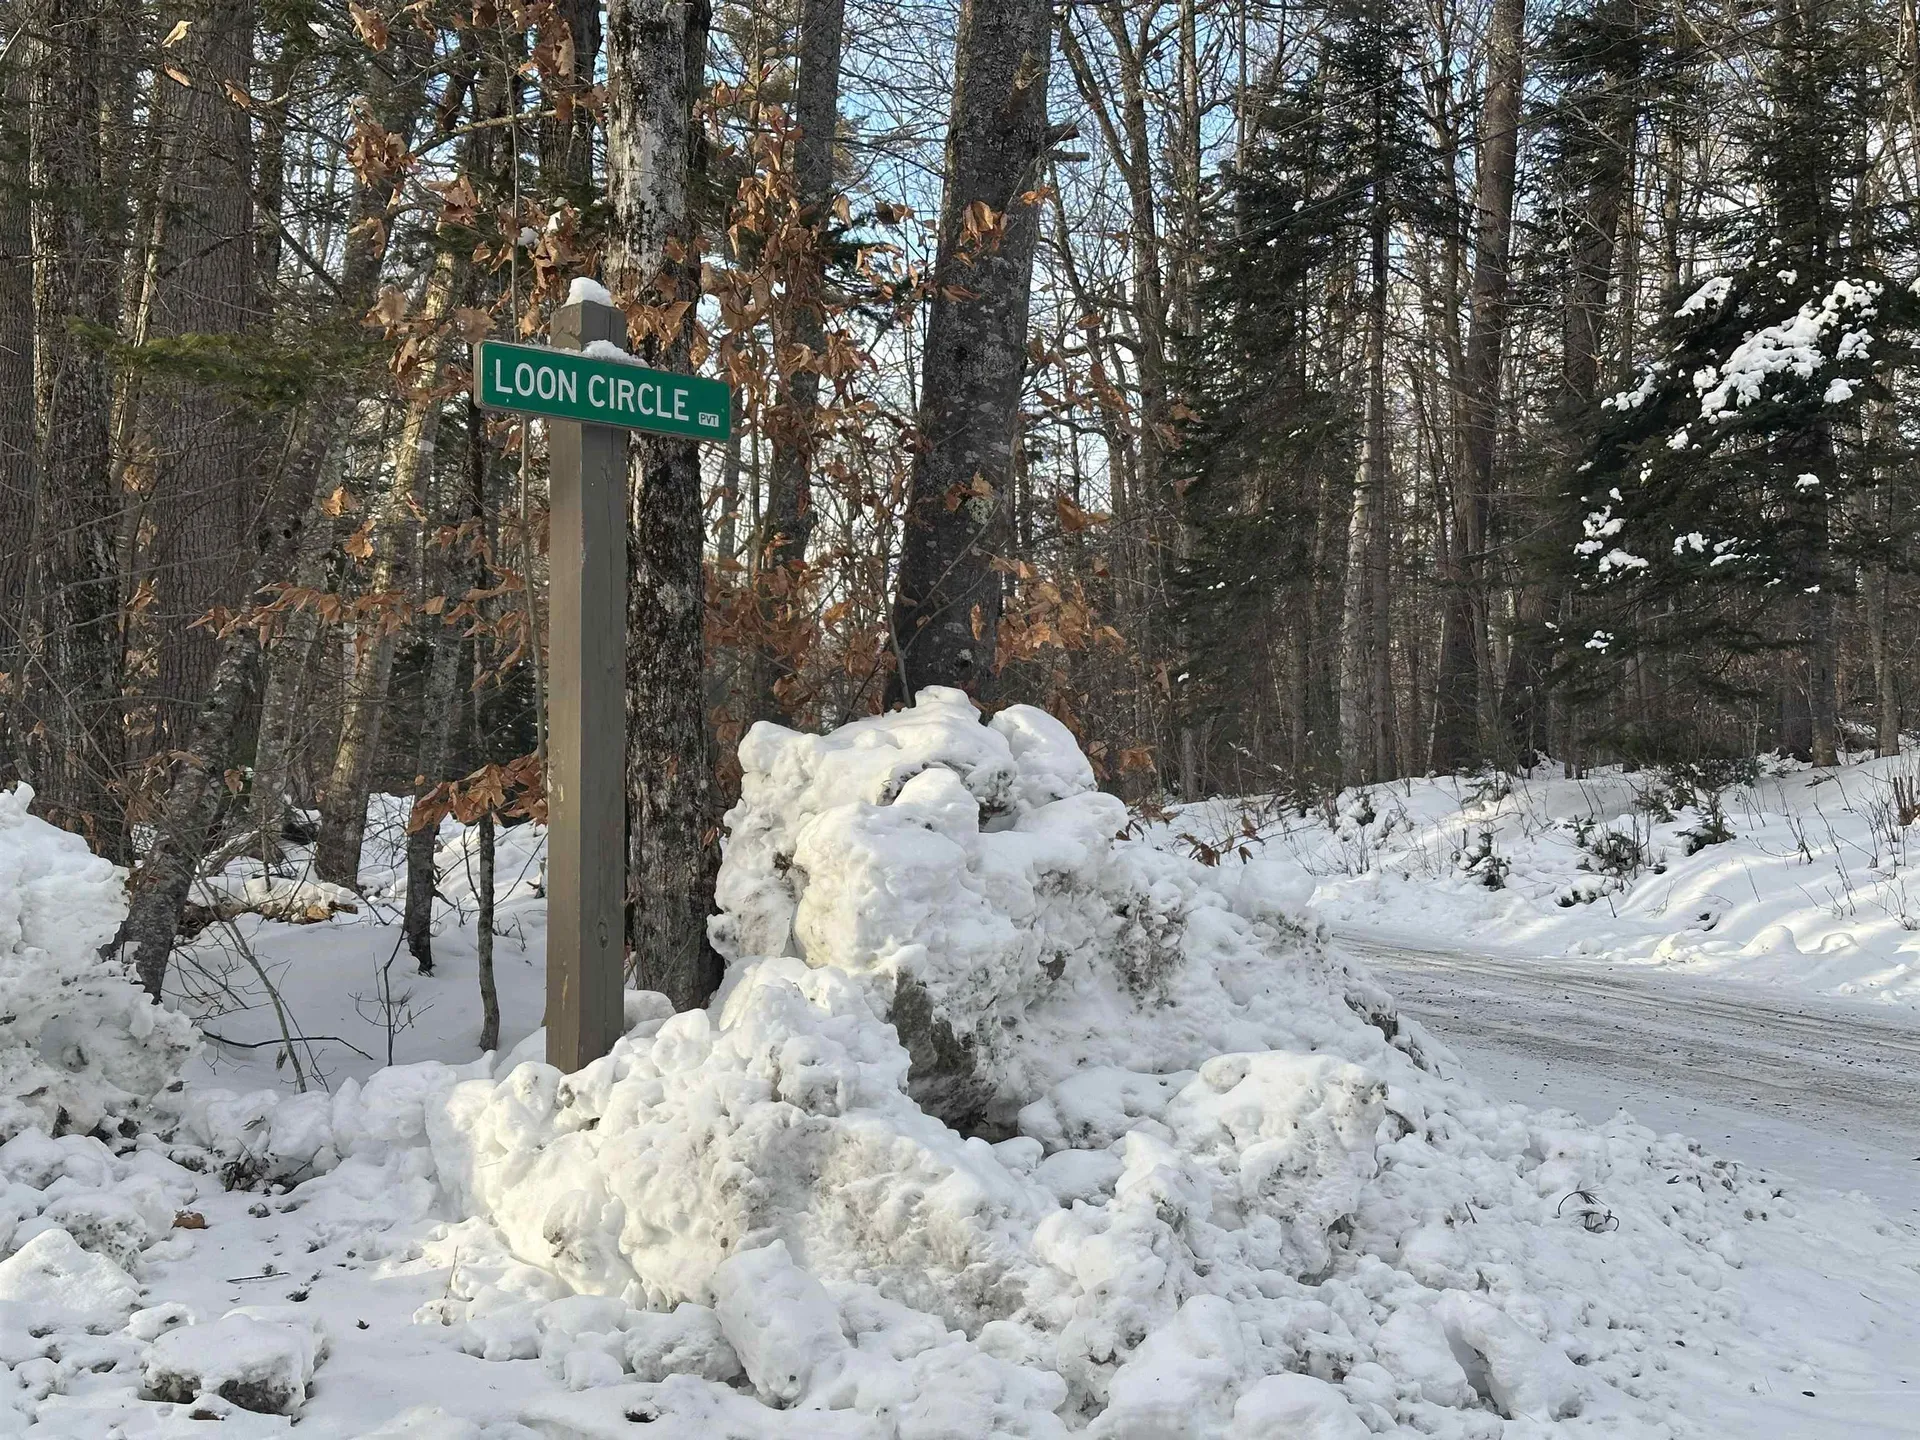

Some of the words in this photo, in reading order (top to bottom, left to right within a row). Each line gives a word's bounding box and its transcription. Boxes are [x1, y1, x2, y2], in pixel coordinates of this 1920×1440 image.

[495, 358, 577, 404] LOON
[588, 374, 690, 421] CIRCLE
[700, 413, 718, 426] PVT
